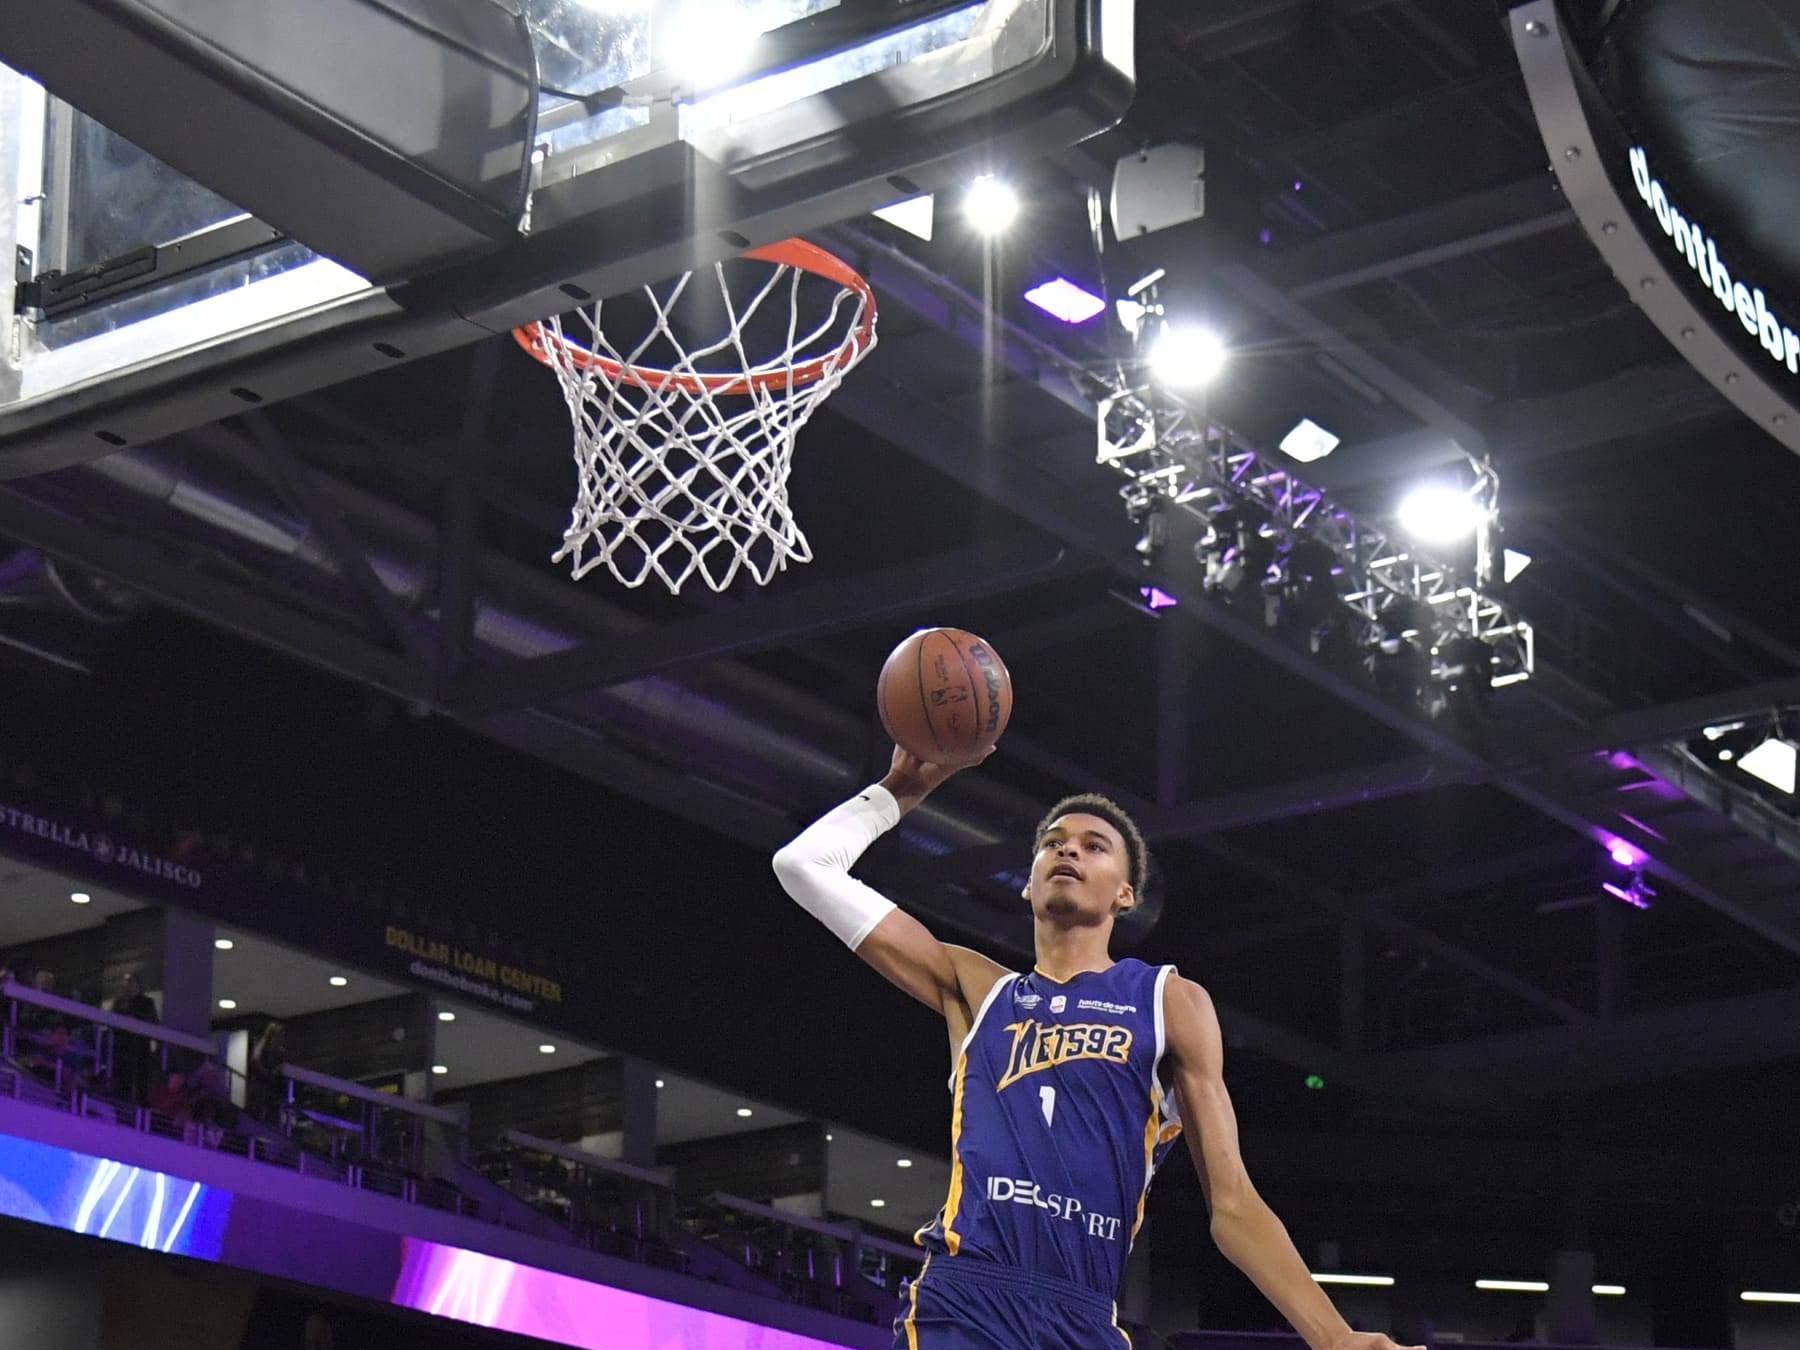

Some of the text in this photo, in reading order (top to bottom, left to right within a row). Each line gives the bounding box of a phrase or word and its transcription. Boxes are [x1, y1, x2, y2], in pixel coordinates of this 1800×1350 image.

[117, 846, 201, 888] JALISCO
[386, 925, 562, 1001] DOLLAR LOAN CENTER
[1039, 1085, 1056, 1128] 1
[1047, 1193, 1121, 1241] SPRT
